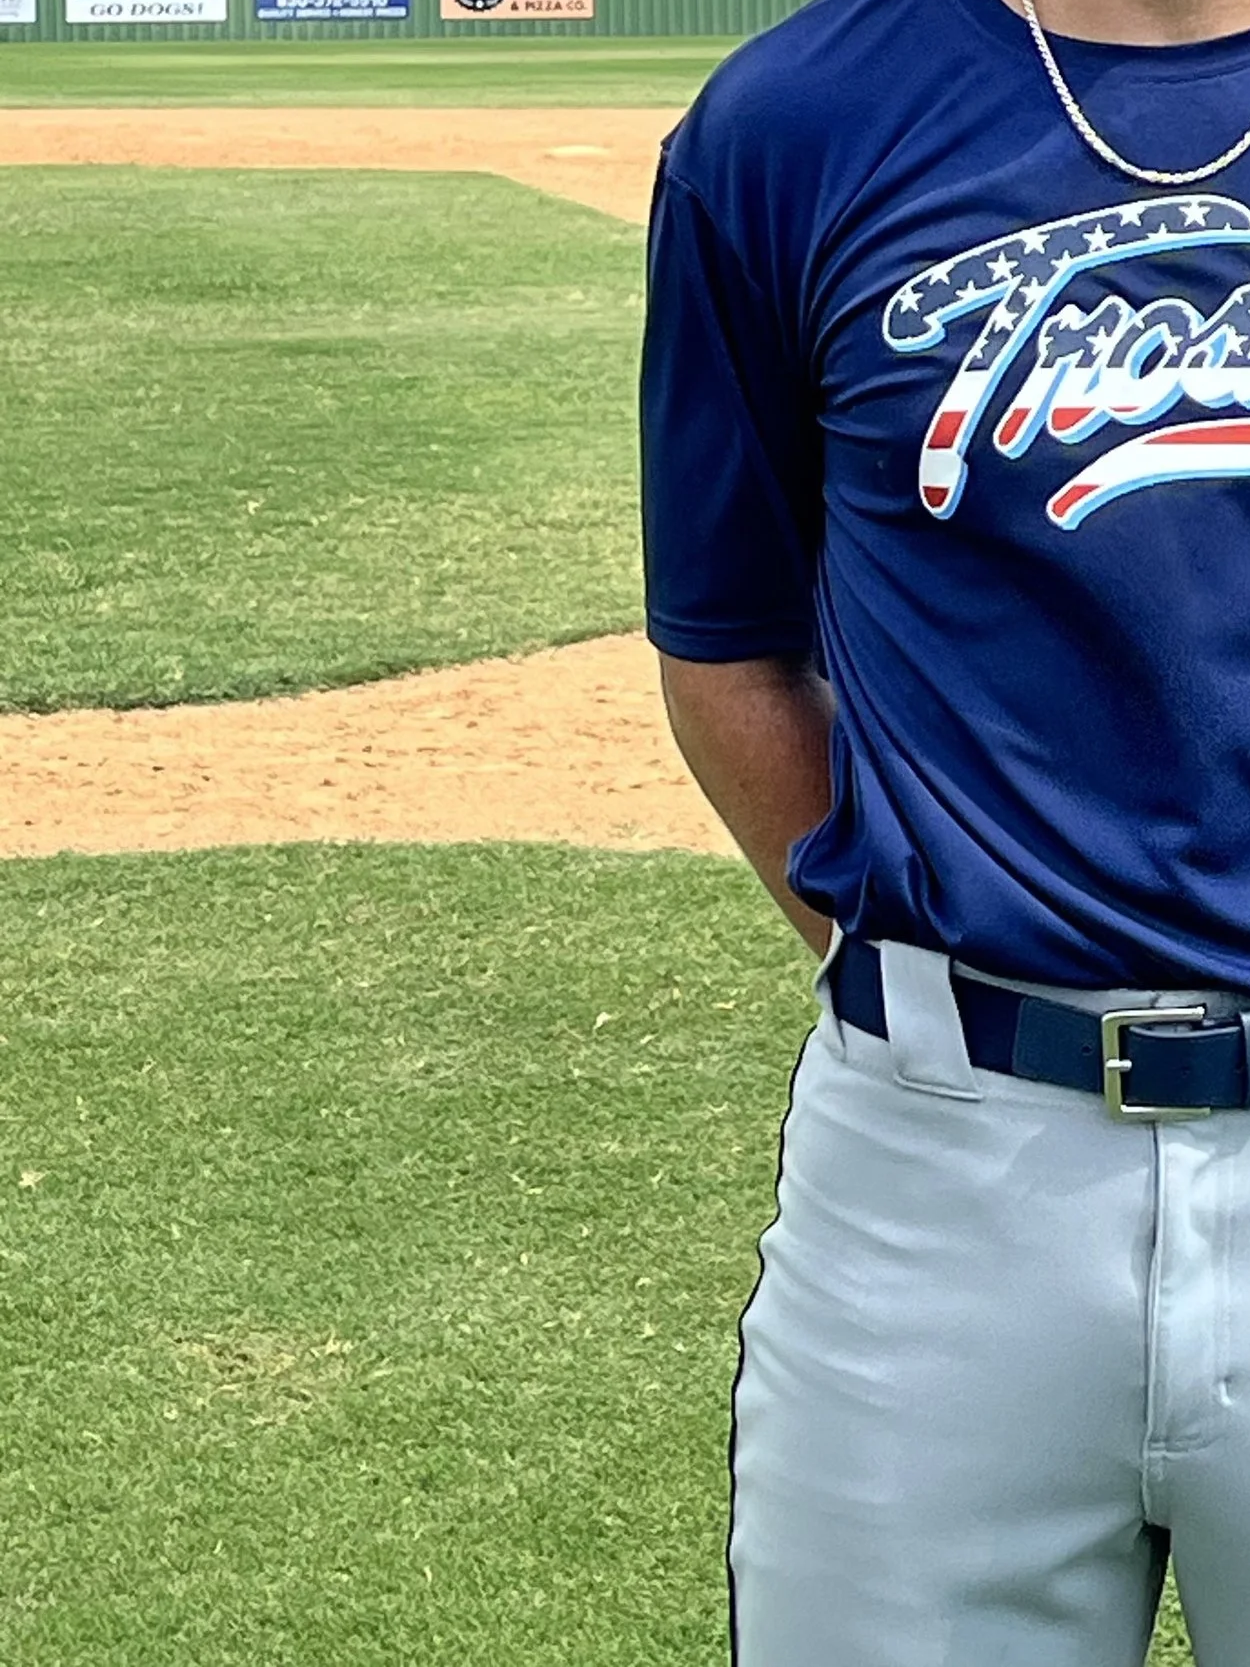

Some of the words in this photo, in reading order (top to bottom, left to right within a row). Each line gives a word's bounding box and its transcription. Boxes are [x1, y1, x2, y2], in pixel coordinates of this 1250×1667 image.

[90, 3, 123, 16] GO
[130, 2, 204, 16] DOGS!
[525, 1, 562, 11] PIZZA
